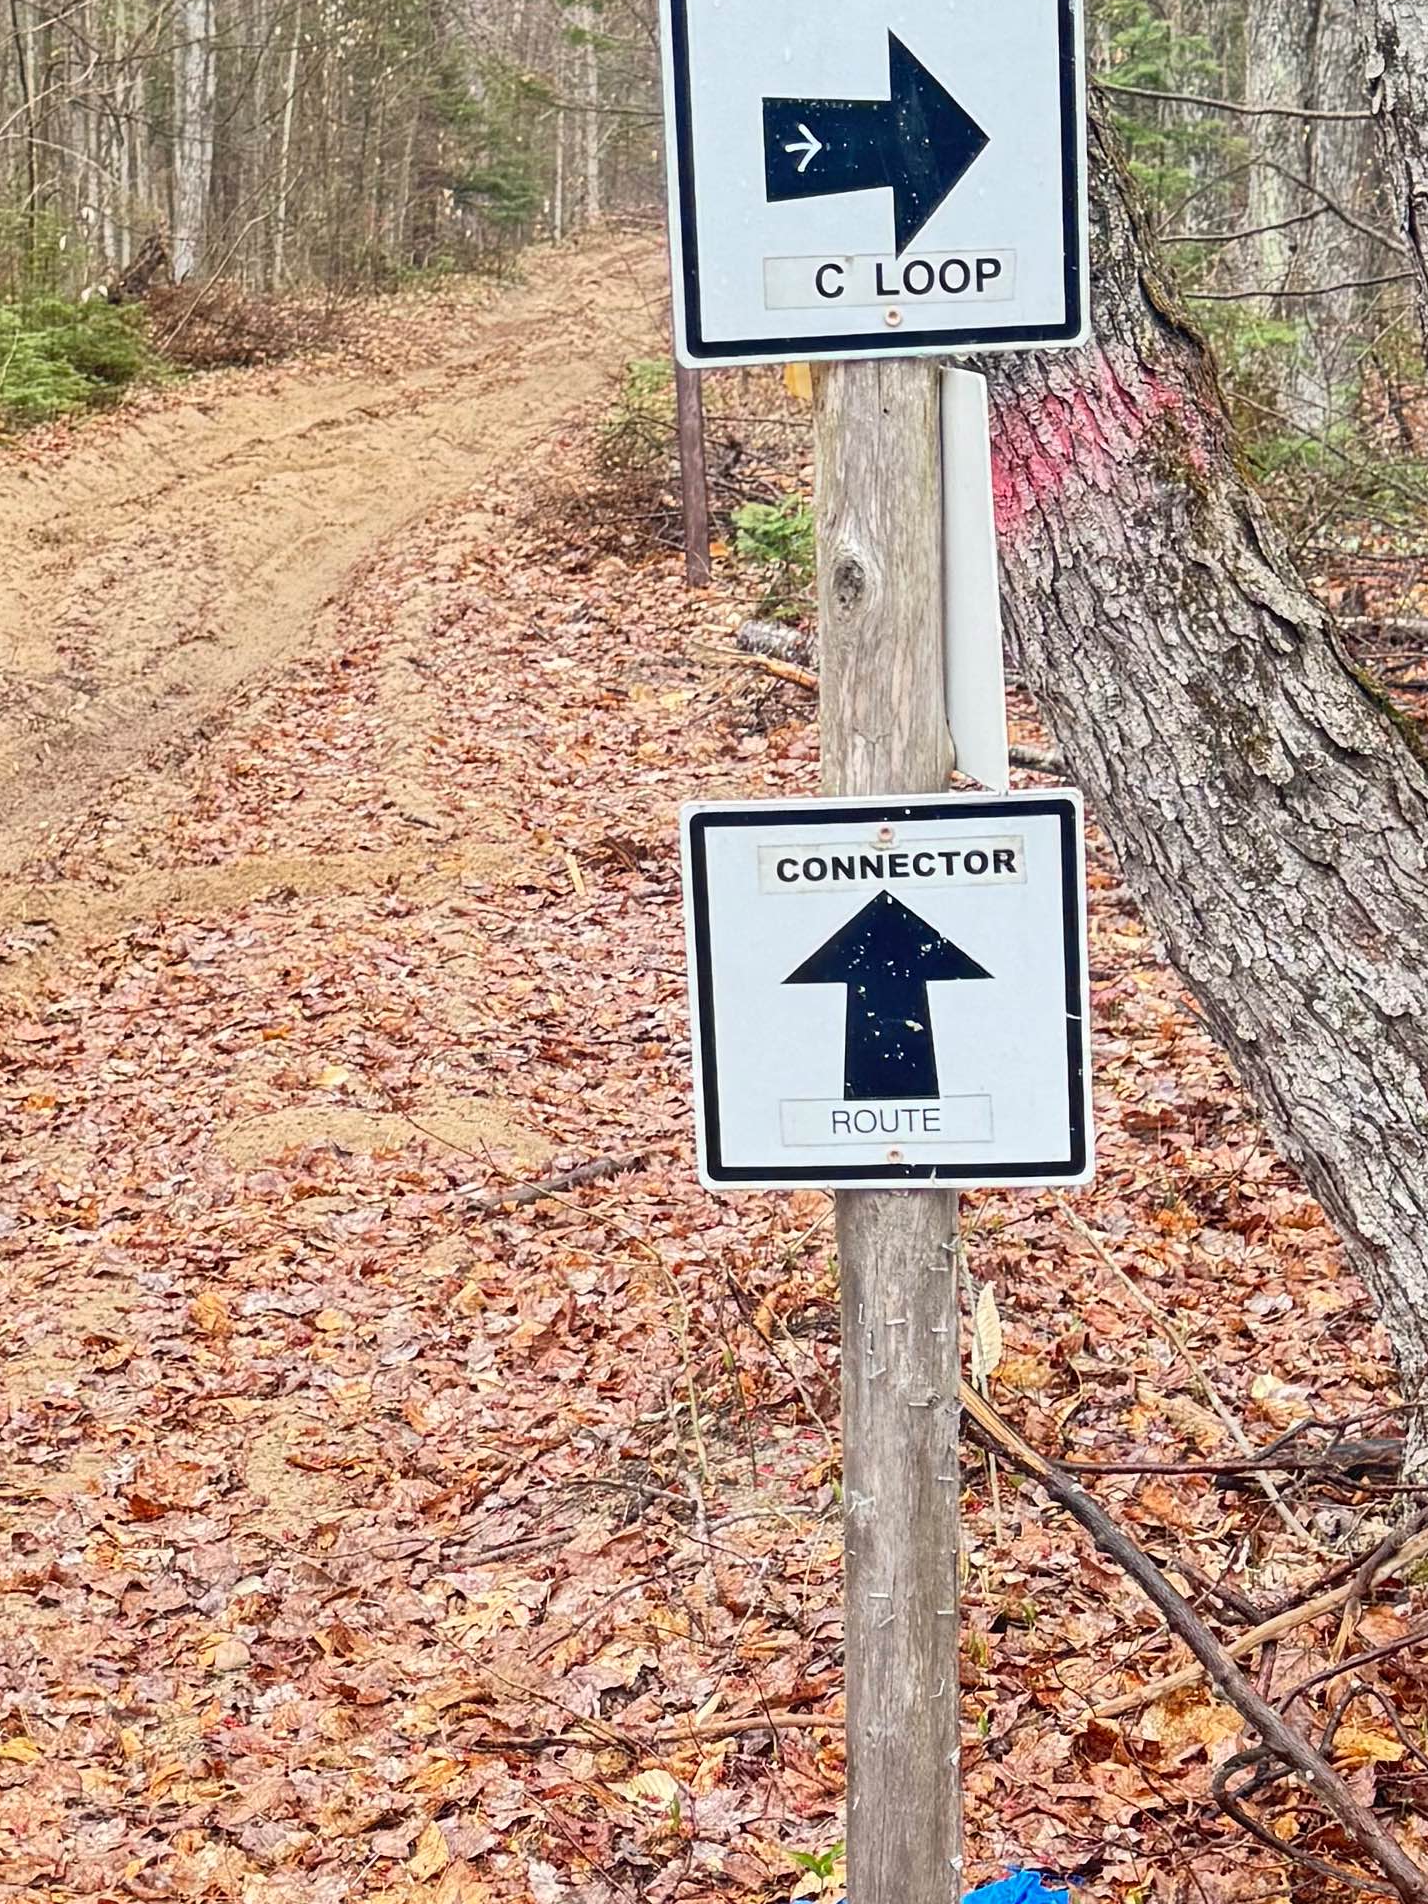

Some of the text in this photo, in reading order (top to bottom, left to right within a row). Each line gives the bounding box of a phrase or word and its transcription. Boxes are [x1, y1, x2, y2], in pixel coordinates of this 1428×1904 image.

[815, 257, 1002, 298] C LOOP
[776, 848, 1018, 883] CONNECTOR
[831, 1108, 942, 1134] ROUTE
